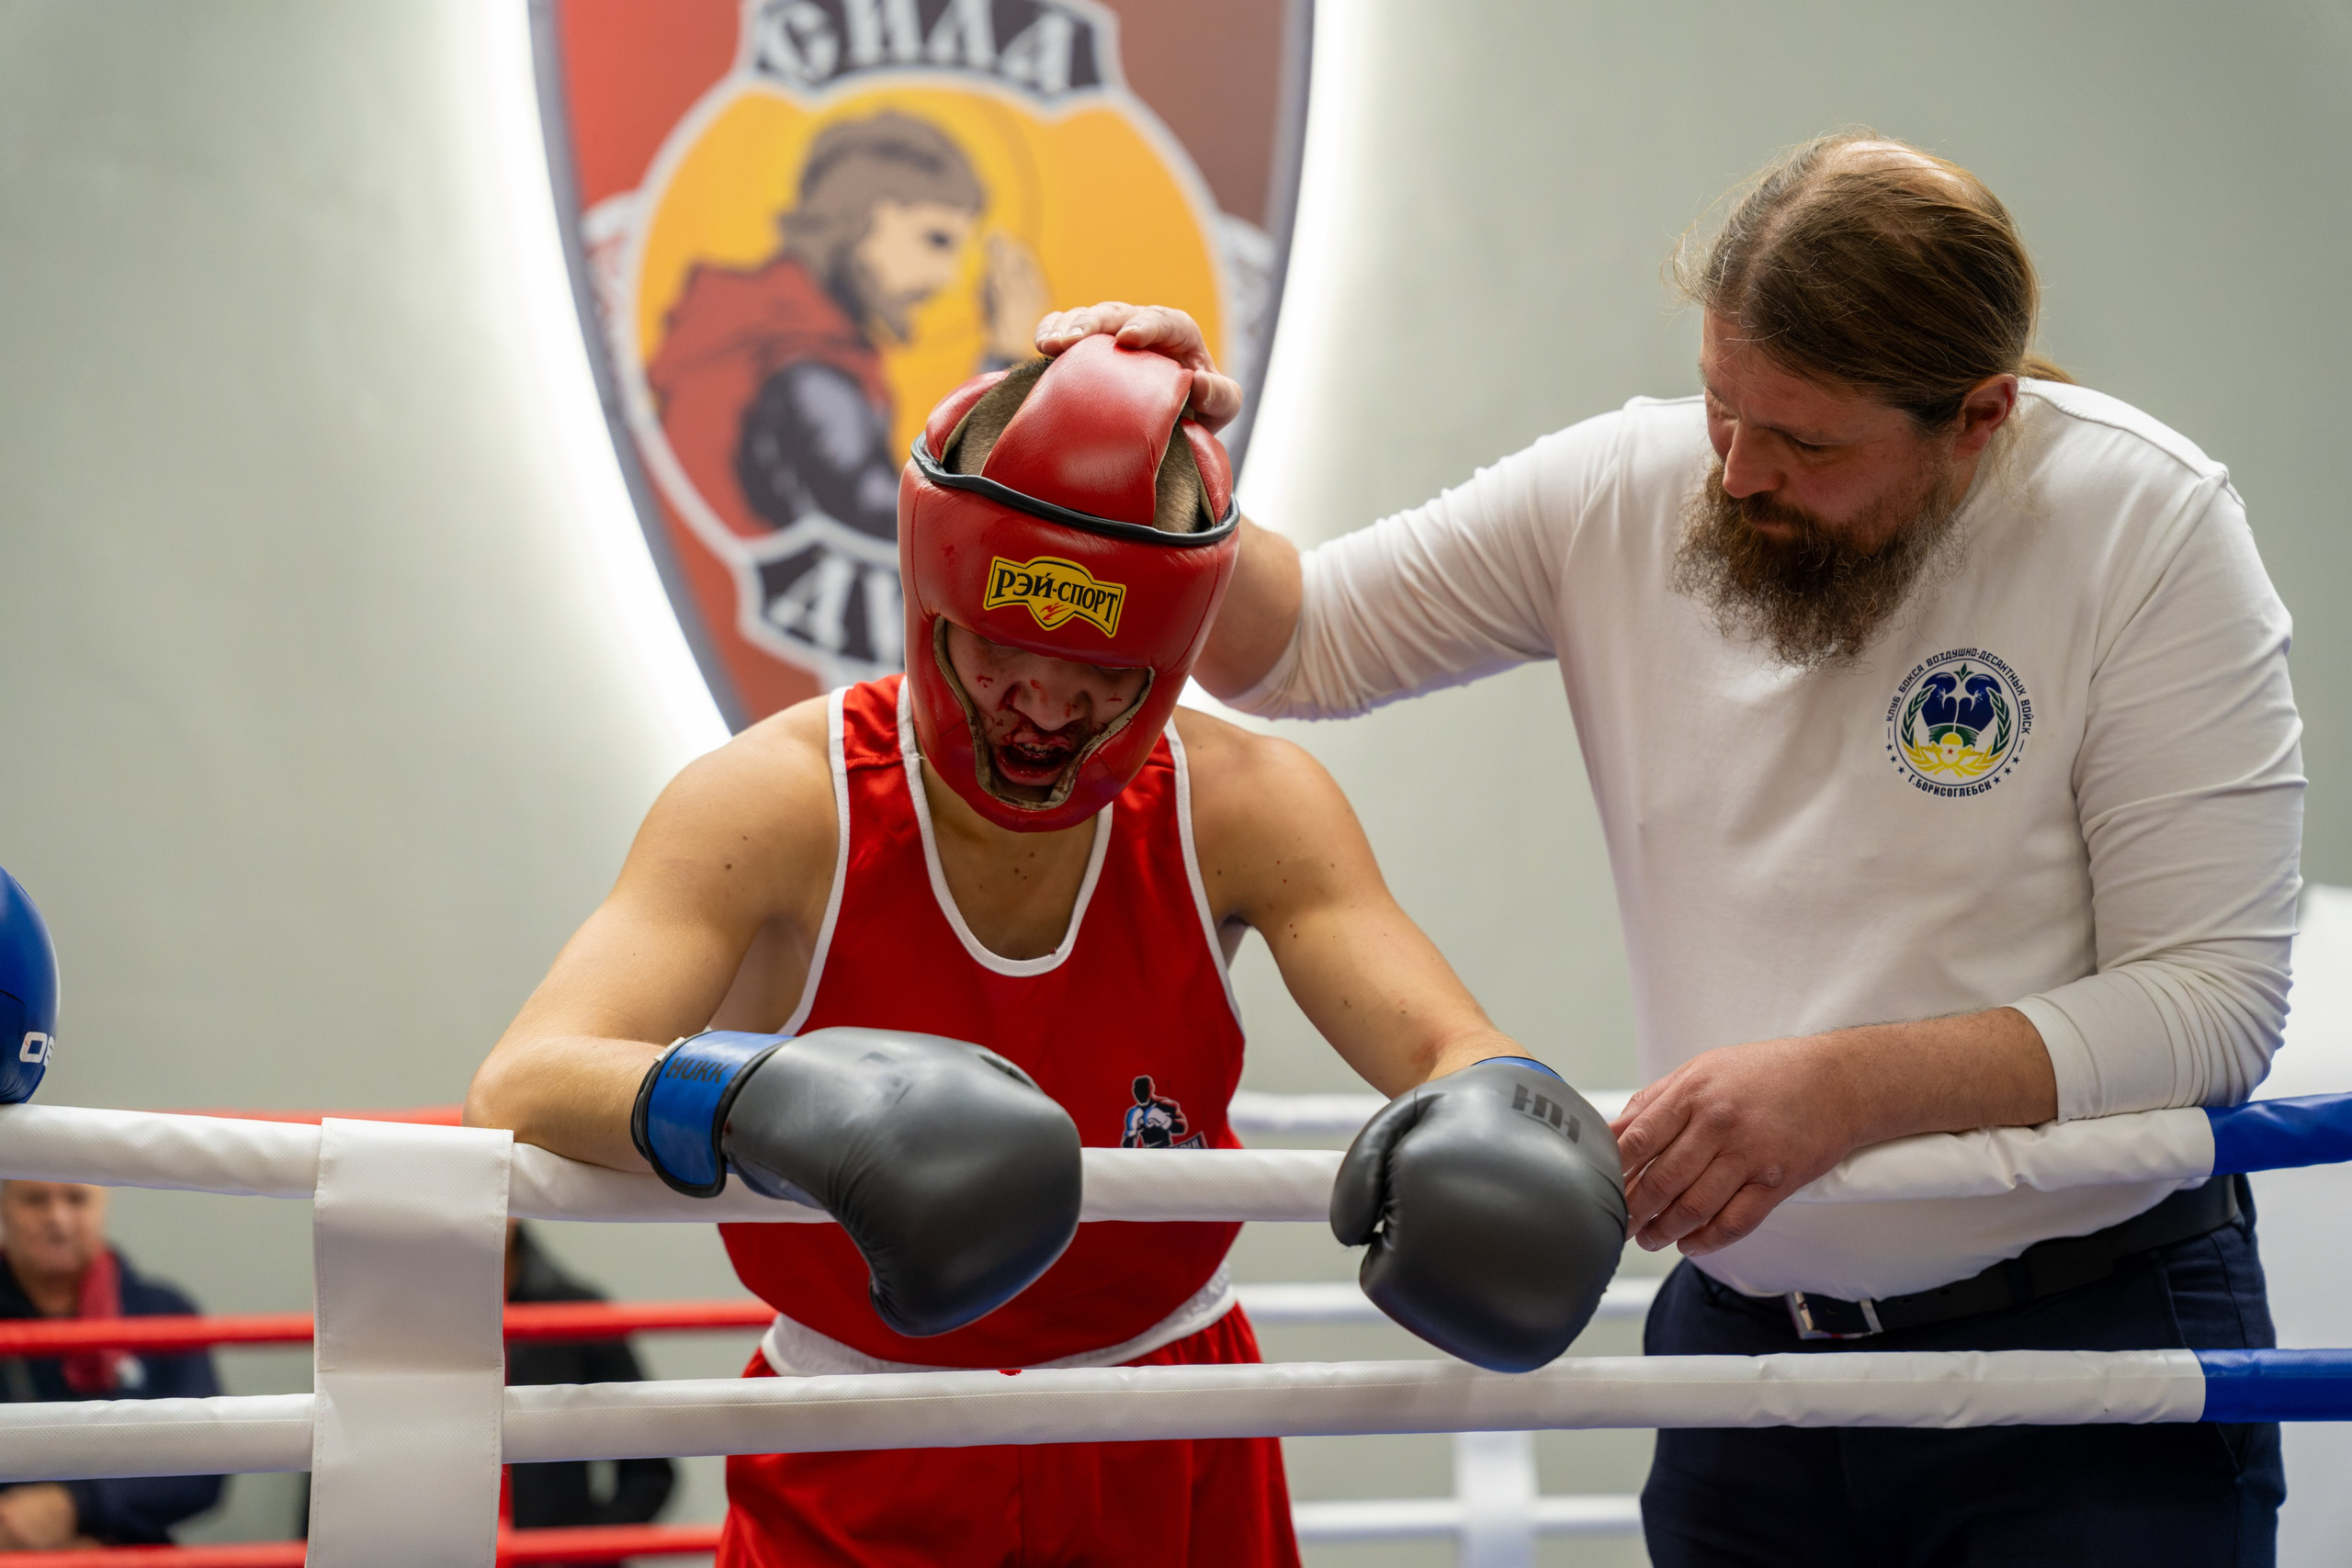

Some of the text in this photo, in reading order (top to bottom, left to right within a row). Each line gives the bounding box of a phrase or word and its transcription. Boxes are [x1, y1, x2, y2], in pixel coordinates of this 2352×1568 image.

[991, 568, 1118, 624] РЭЙ-СПОРТ
[1886, 695, 1901, 722] КЛУБ
[1898, 664, 1925, 694] БОКСА
[2020, 699, 2034, 735] ВОЙСК
